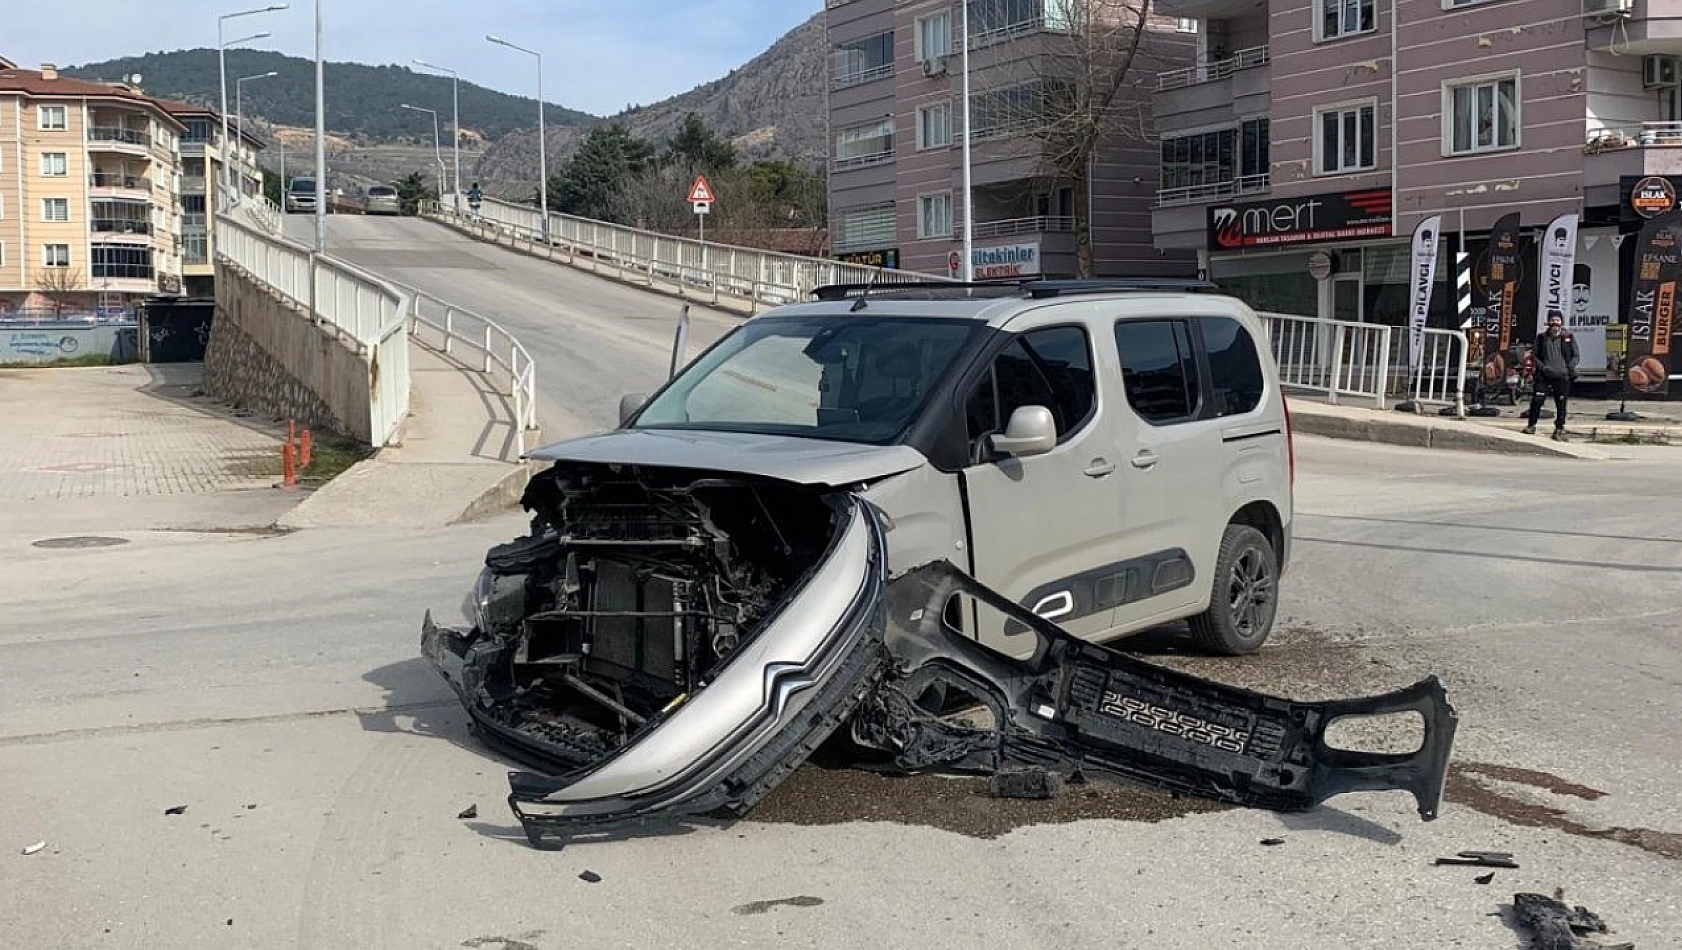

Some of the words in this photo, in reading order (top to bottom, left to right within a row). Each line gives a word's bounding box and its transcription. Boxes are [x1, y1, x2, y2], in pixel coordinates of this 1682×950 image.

[1243, 198, 1322, 234] mert
[1544, 264, 1562, 310] İLAVCI
[1486, 290, 1502, 338] ISLAK
[1631, 289, 1655, 341] ISLAK
[1656, 291, 1671, 345] BURGER
